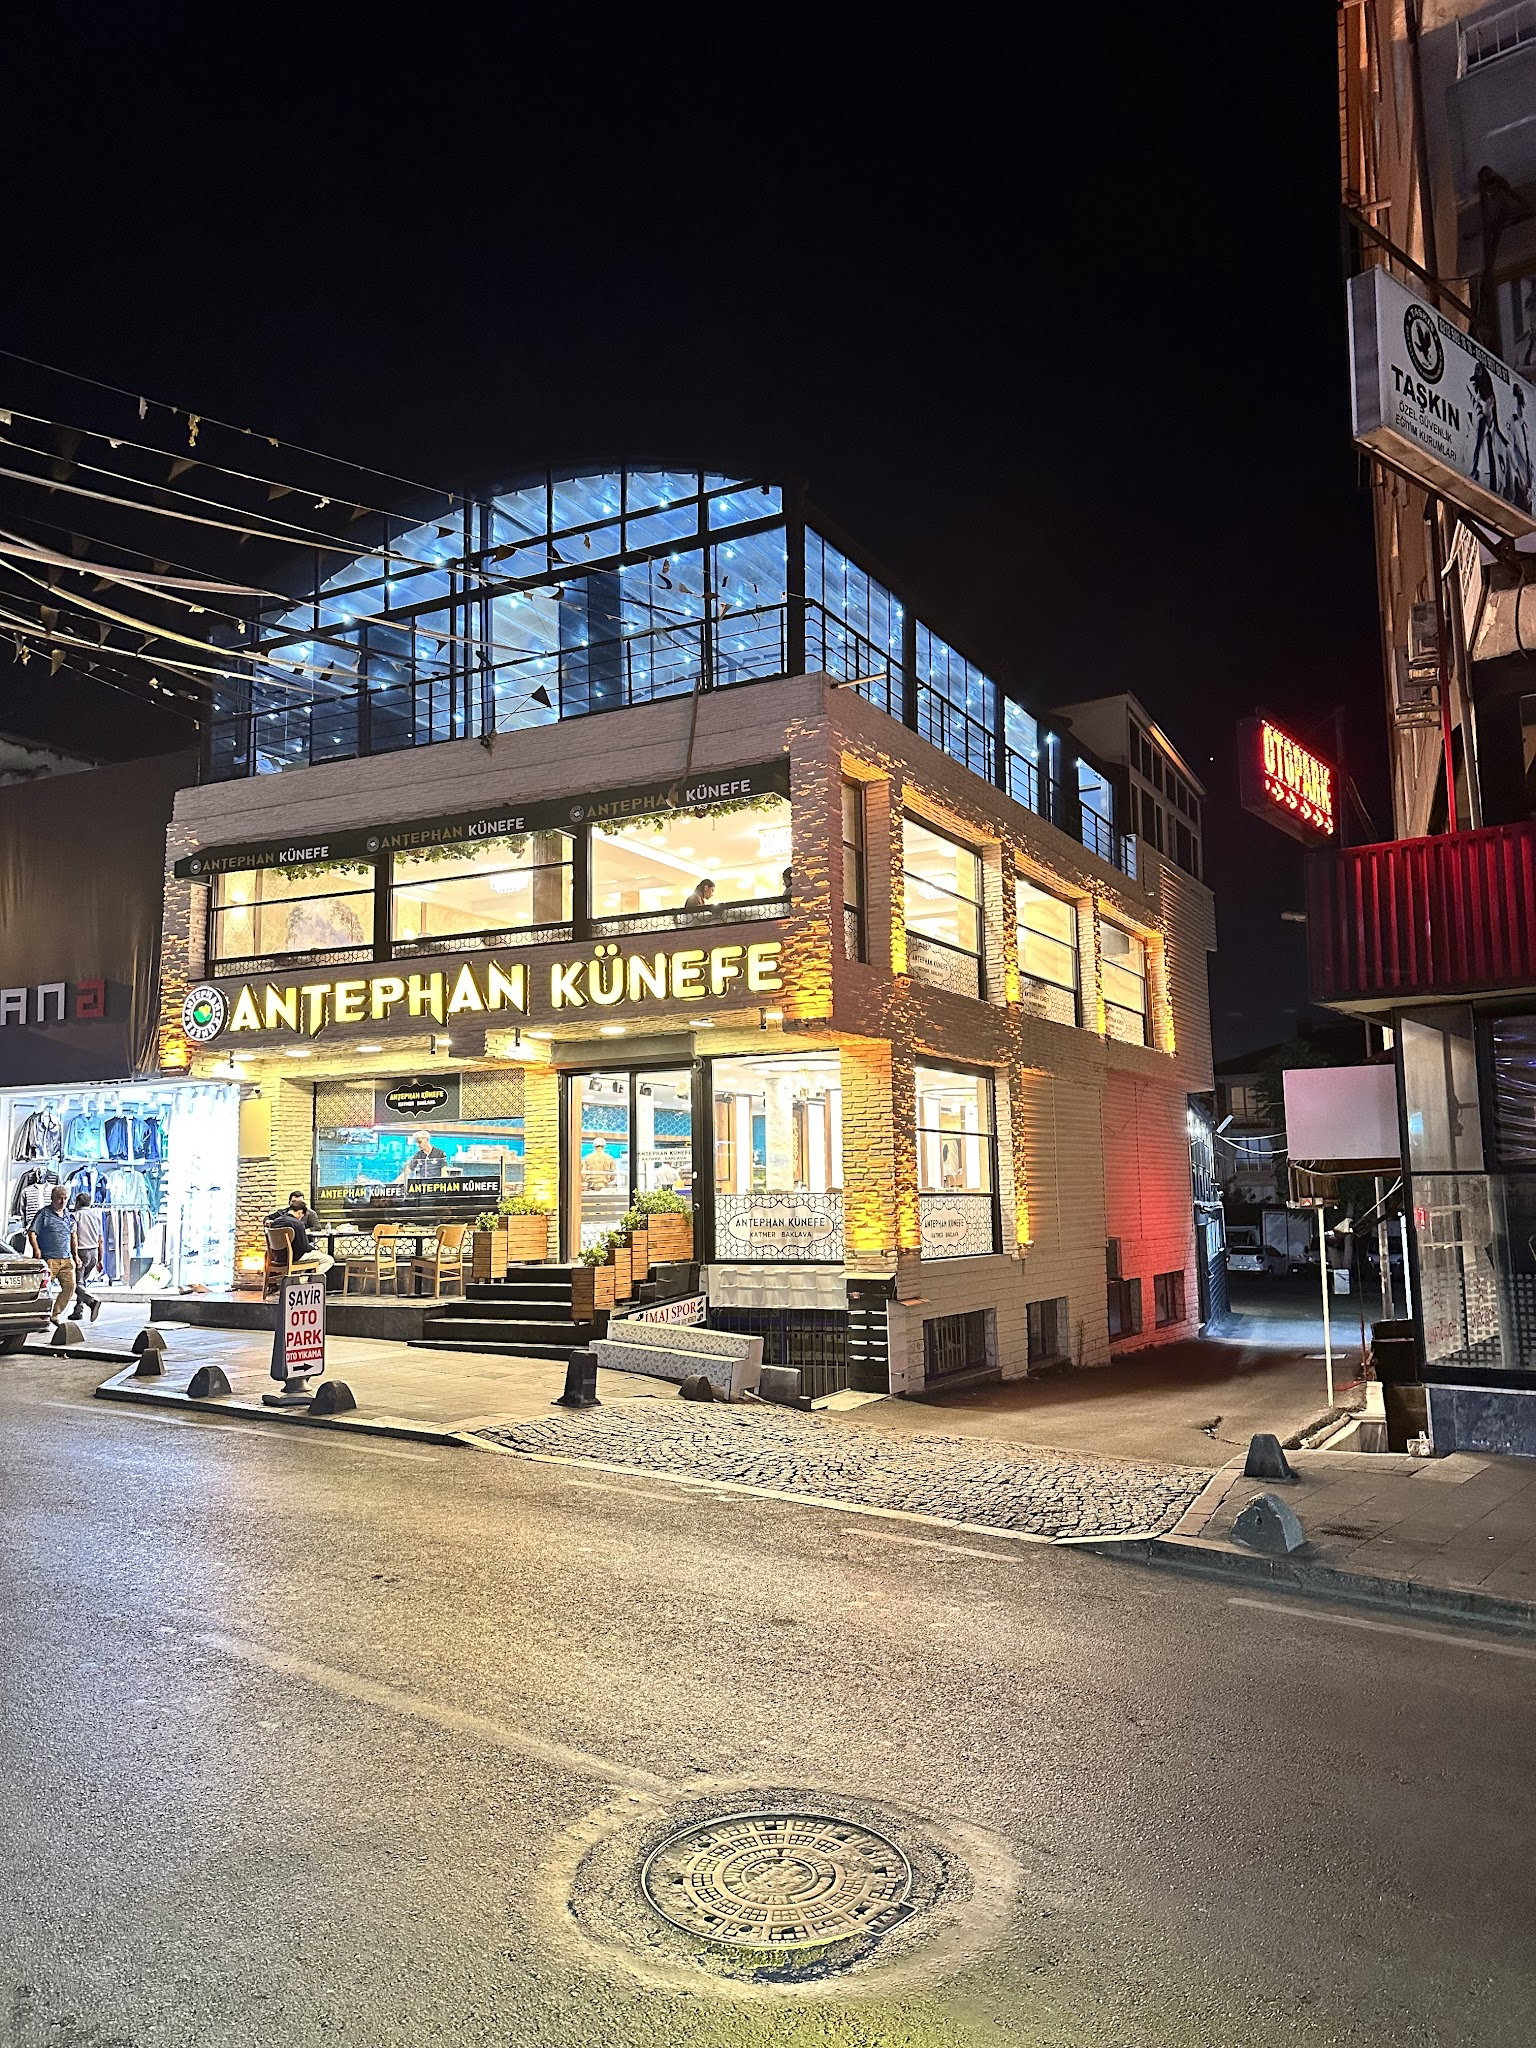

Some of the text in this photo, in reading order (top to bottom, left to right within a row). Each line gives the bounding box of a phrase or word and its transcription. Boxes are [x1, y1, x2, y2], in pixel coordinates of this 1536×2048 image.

[1391, 364, 1460, 432] TAŞKIN
[1399, 400, 1453, 443] ÖZEL GÜVENLİK
[1395, 413, 1457, 461] EĞİTİM KURUMLARI
[1263, 726, 1332, 814] OTOPARK
[686, 779, 751, 802] KÜNEFE
[381, 817, 525, 849] ANTEPHAN KÜNEFE
[202, 846, 329, 872] ANTEPHAN KÜNEFE
[229, 942, 784, 1037] ANTEPHAN KÜNEFE
[389, 1092, 420, 1101] ANTEPHAN
[320, 1185, 401, 1199] ANTEPHAN KÜNEFE
[409, 1180, 499, 1194] ANTEPHAN KÜNEFE
[735, 1216, 825, 1228] ANTEPHAN KÜNEFE
[288, 1286, 321, 1311] ŞAYİR
[291, 1310, 317, 1327] OTO
[645, 1309, 670, 1324] İMAJ
[671, 1301, 697, 1319] SPOR
[286, 1329, 322, 1348] PARK
[286, 1349, 321, 1361] OTO YIKAMA
